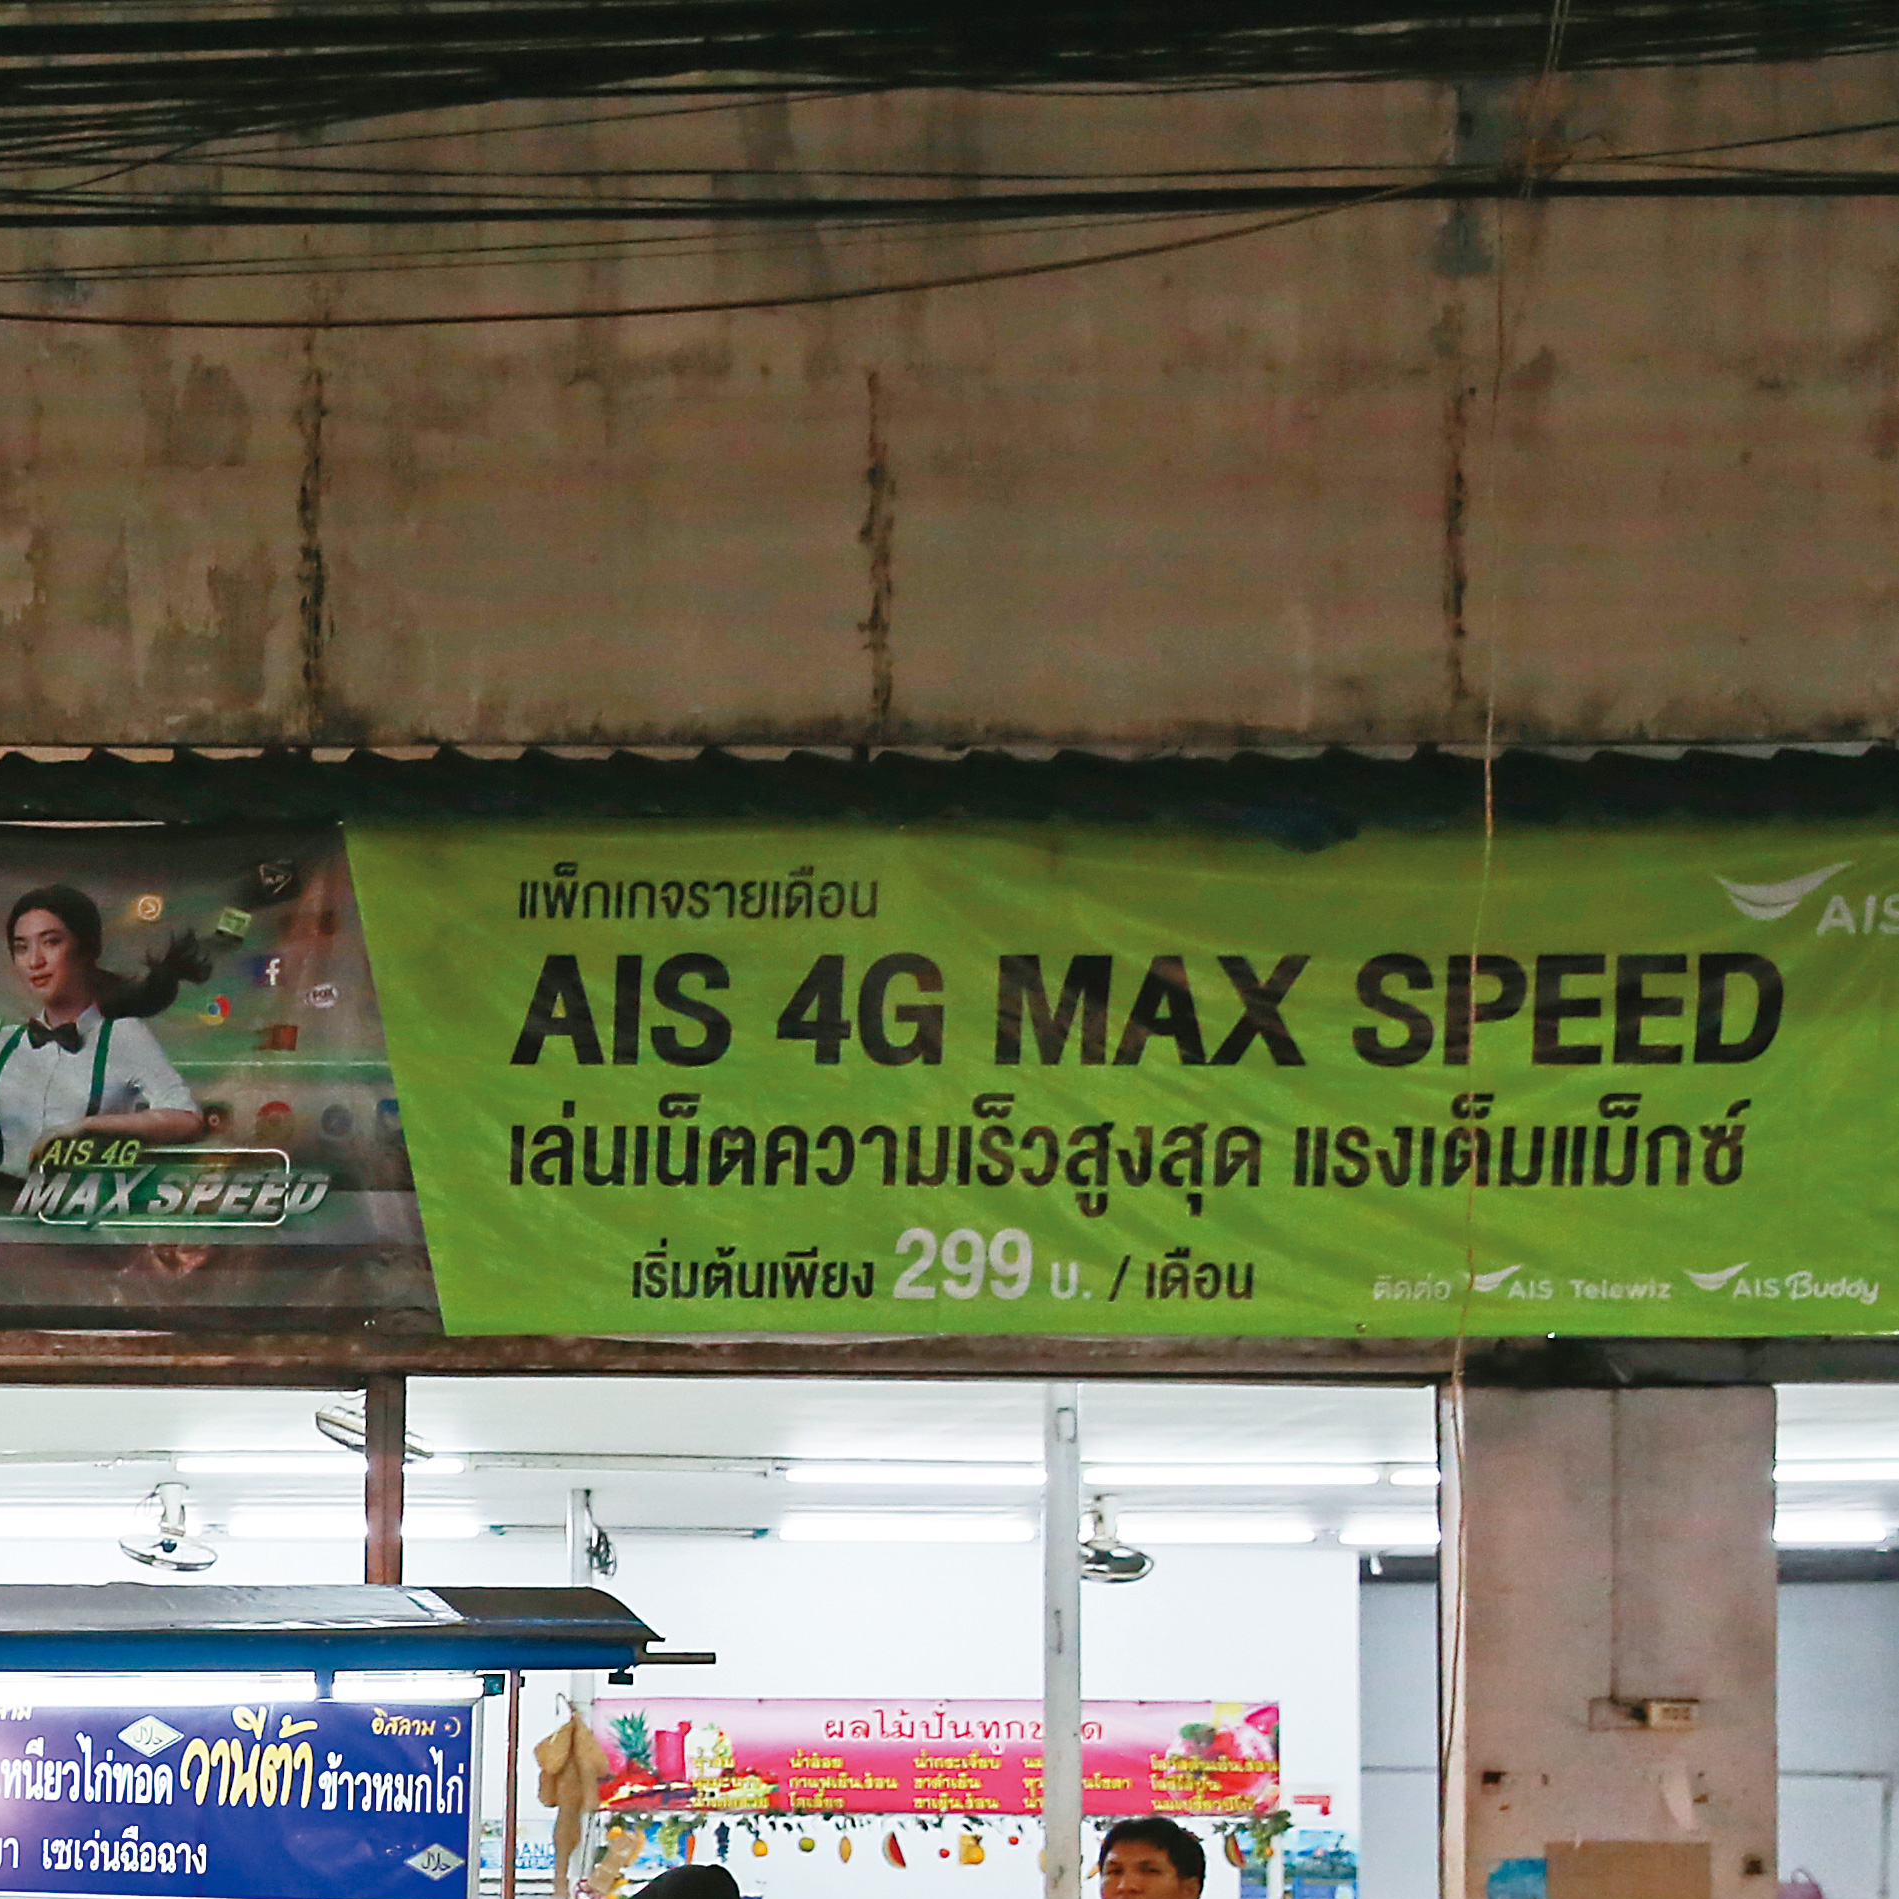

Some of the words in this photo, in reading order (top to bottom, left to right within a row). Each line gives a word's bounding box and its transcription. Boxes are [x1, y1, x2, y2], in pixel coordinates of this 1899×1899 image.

[518, 863, 879, 919] แพ็กเกจรายเดือน
[510, 953, 731, 1066] AIS
[776, 953, 944, 1066] 4G
[995, 953, 1311, 1066] MAX
[1352, 952, 1784, 1067] SPEED
[42, 1139, 95, 1166] AIS
[101, 1139, 141, 1166] 4G
[510, 1093, 1262, 1218] เล่นเน็ตความเร็วสูงสุด
[1293, 1092, 1751, 1188] แรงเต็มแม็กซ์
[12, 1168, 154, 1217] MAX
[148, 1173, 331, 1216] SPEED
[632, 1239, 873, 1300] เริ่มต้นเพียง
[893, 1227, 1033, 1300] 299
[1049, 1261, 1091, 1300] บ.
[1145, 1249, 1255, 1300] เดือน
[1508, 1280, 1553, 1299] AIS
[1570, 1279, 1671, 1299] Telewiz
[1733, 1278, 1780, 1299] AIS
[1785, 1271, 1878, 1305] Buddy
[371, 1707, 436, 1737] อิสลาม
[318, 1747, 466, 1816] ข้าวหมกไก่
